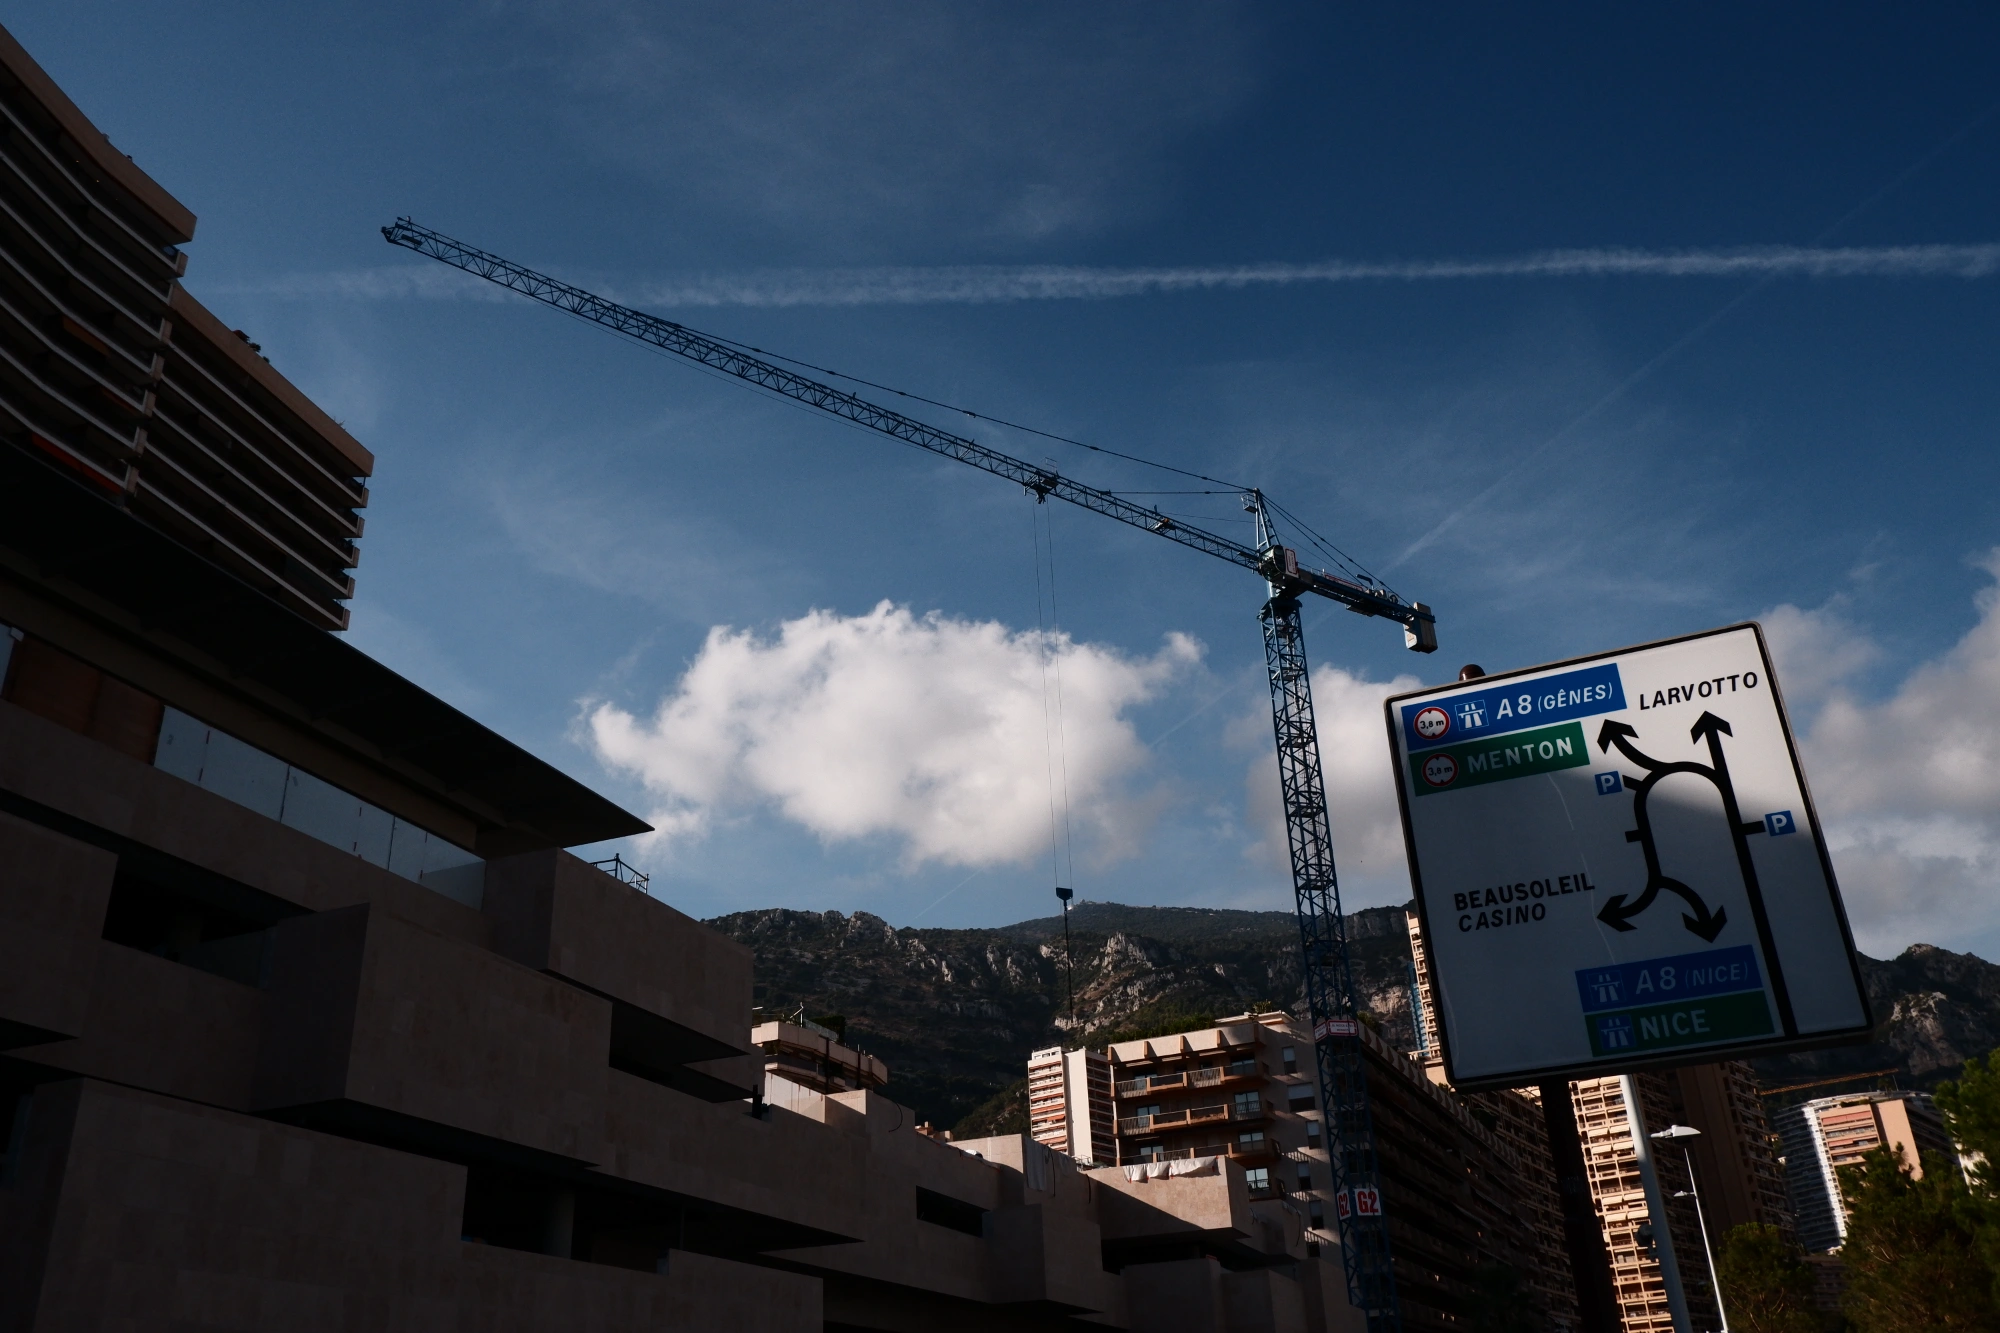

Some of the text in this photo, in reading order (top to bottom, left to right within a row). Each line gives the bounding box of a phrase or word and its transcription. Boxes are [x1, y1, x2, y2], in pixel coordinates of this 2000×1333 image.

[1496, 682, 1613, 720] A8 (GÊNES)
[1640, 671, 1758, 711] LARVOTTO
[1467, 736, 1573, 774] MENTON
[1600, 774, 1615, 793] P
[1772, 814, 1787, 833] P
[1454, 873, 1595, 911] BEAUSOLEIL
[1459, 903, 1546, 932] CASINO
[1635, 961, 1748, 995] A8 (NICE)
[1640, 1008, 1711, 1041] NICE
[1357, 1191, 1378, 1213] G2
